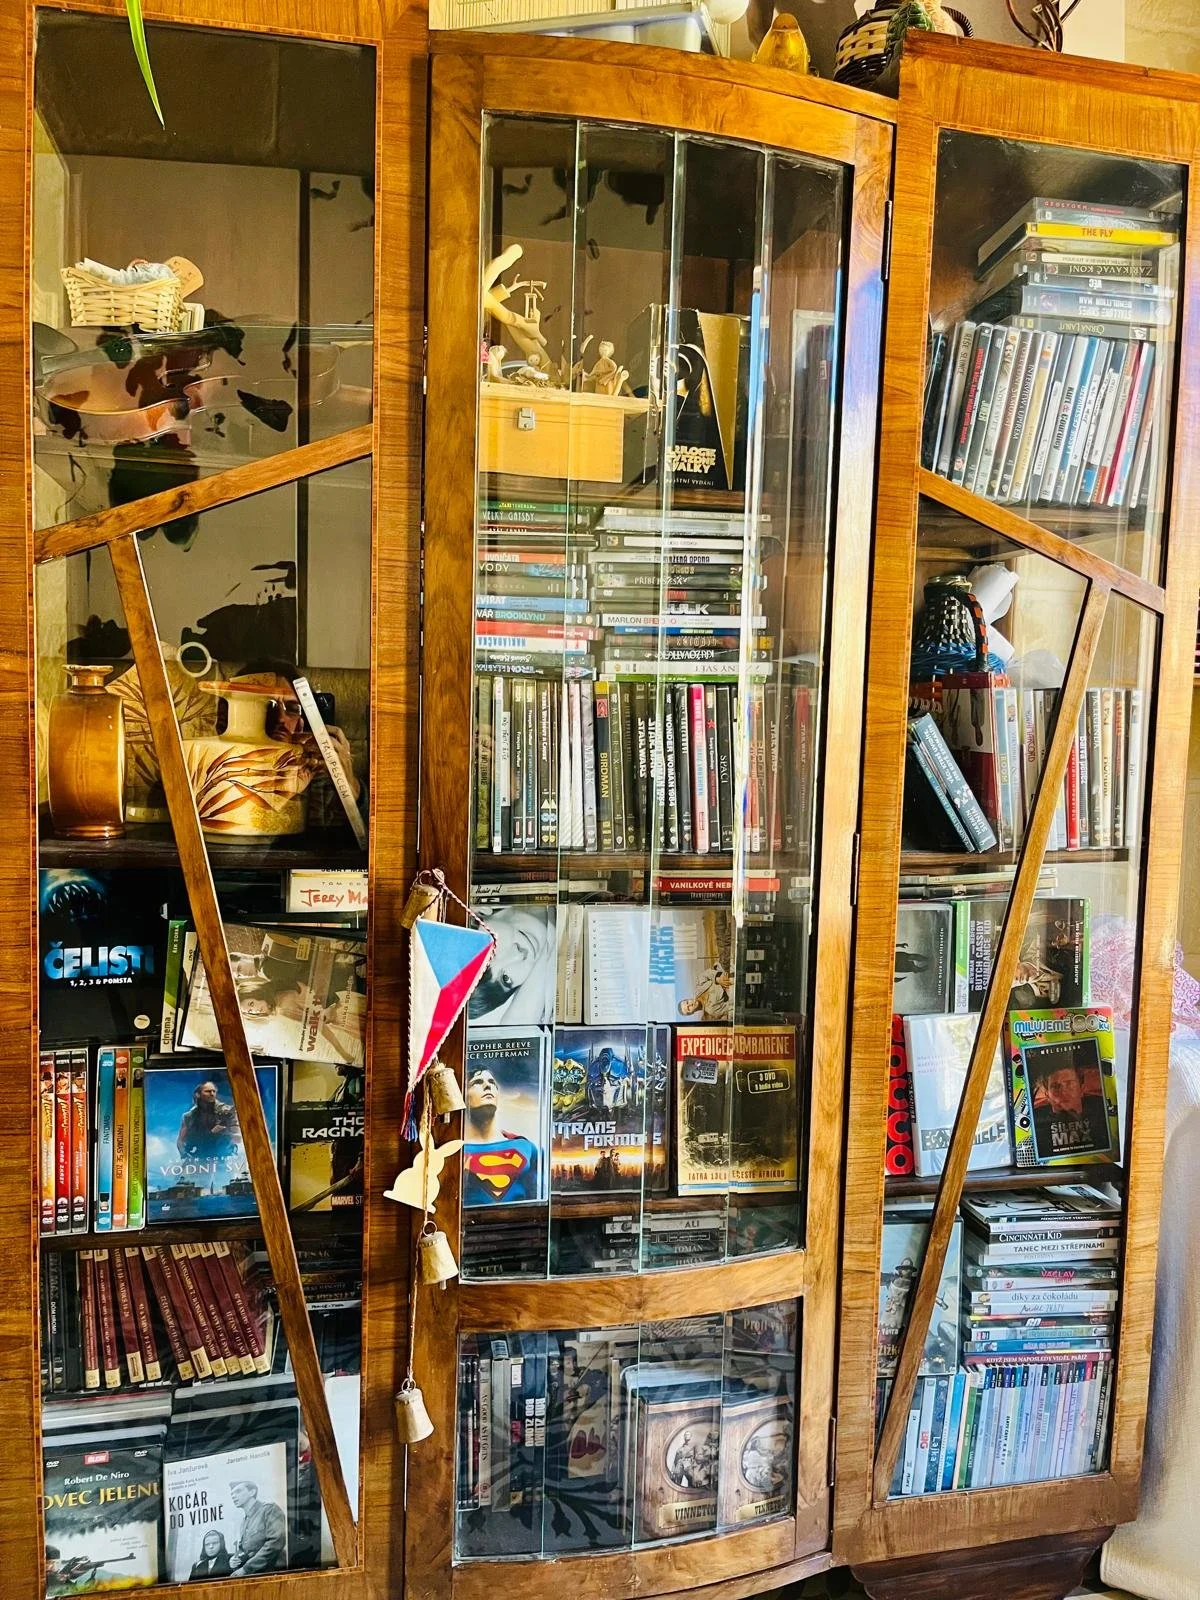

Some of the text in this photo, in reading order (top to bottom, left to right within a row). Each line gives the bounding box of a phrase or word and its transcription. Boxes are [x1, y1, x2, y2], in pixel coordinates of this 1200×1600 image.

[1082, 228, 1113, 237] THE FLY
[508, 513, 535, 521] GATSBY
[495, 612, 545, 620] BROOKLYNU
[665, 714, 673, 752] WONDER
[600, 752, 608, 798] BIRDMAN
[667, 754, 675, 788] WOMAN
[969, 806, 988, 832] SUNIM
[670, 880, 713, 888] VANILKOVÉ
[975, 920, 984, 991] BUTCH CASSIDY
[304, 1009, 321, 1052] walk
[1015, 1019, 1070, 1033] MILUJEME
[759, 1072, 776, 1081] 3 DVD
[1052, 1131, 1092, 1147] MAX
[159, 1163, 218, 1176] VODNÍ
[331, 1196, 354, 1205] MARVEL
[685, 1220, 700, 1228] ALI
[1048, 1231, 1062, 1239] KID
[1061, 1242, 1105, 1250] STŘEPINAMI
[1043, 1292, 1078, 1300] čokoládu
[525, 1398, 534, 1447] BOD ZLOMU
[920, 1431, 928, 1449] BIG
[929, 1436, 941, 1462] Lajka
[64, 1476, 93, 1485] Robert
[111, 1471, 130, 1479] Niro
[44, 1491, 92, 1510] OVEC
[169, 1490, 208, 1512] KOČÁR
[170, 1514, 184, 1529] DO
